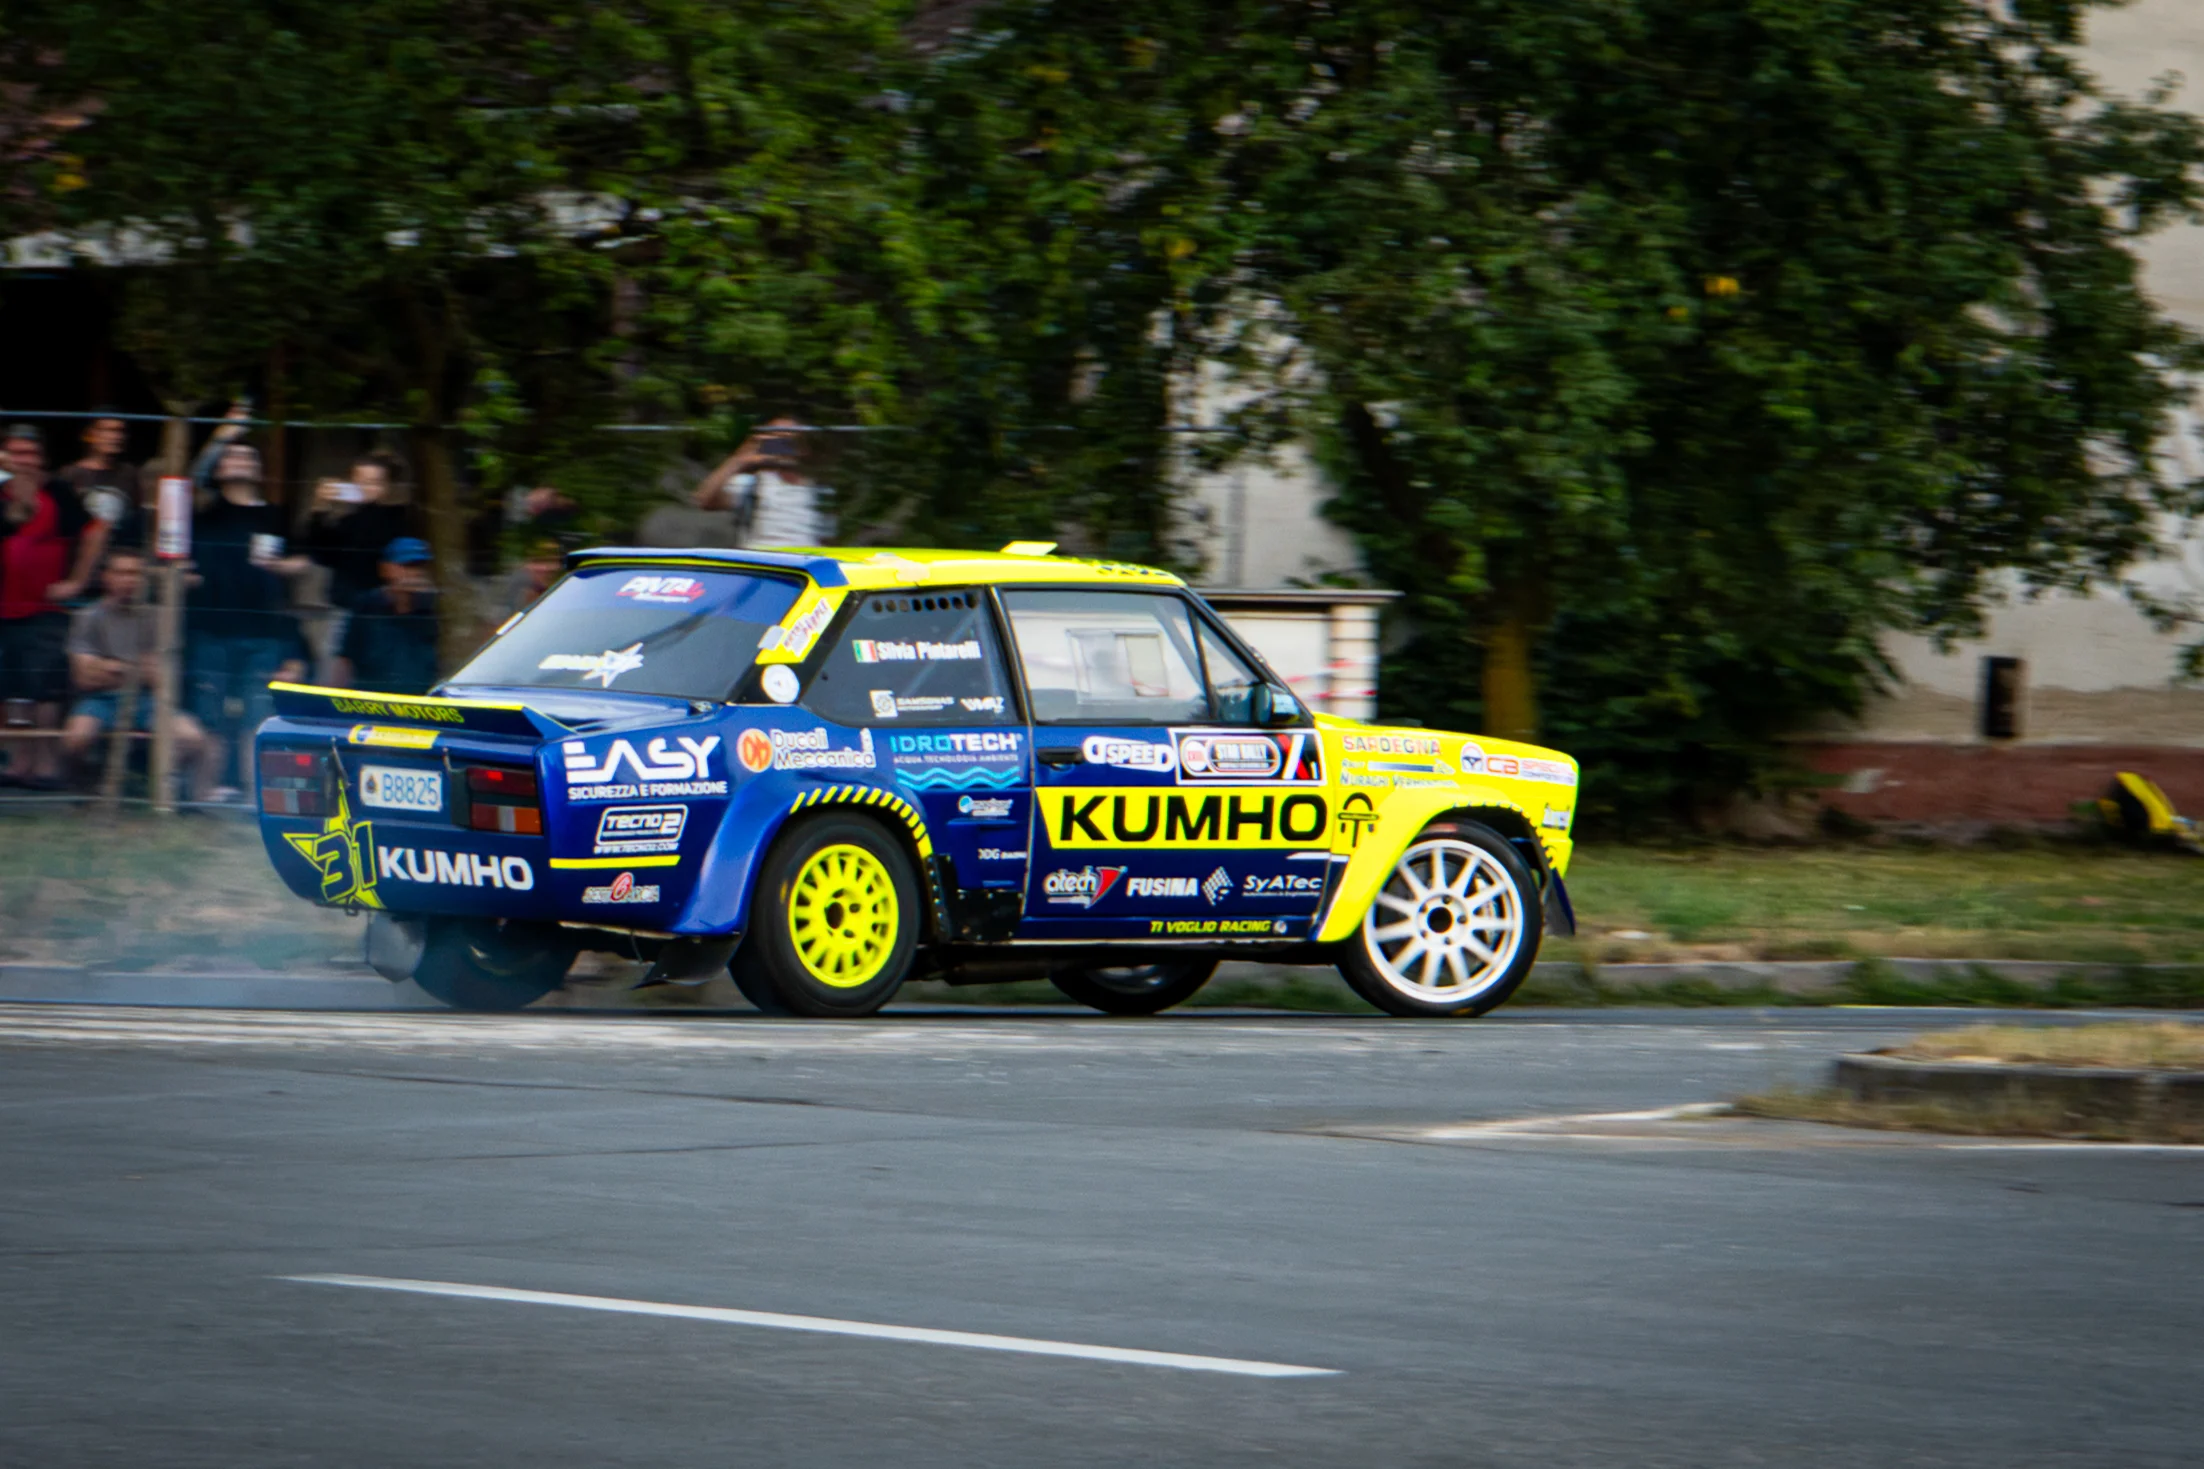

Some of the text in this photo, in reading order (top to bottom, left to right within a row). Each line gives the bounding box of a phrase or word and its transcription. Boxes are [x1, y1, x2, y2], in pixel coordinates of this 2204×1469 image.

[877, 640, 982, 660] Silvia Pintarelli
[389, 703, 464, 723] MOTORS
[772, 728, 828, 749] Ducoli
[890, 733, 1017, 752] IDROTECH
[1343, 736, 1442, 756] SARDEGNA
[563, 735, 721, 784] EASY
[776, 748, 875, 769] Meccanica
[383, 773, 437, 806] B8825
[568, 781, 728, 800] SICUREZZA E FORMAZIONE
[1060, 794, 1327, 842] KUMHO
[313, 821, 377, 901] 31
[378, 846, 535, 891] KUMHO
[1126, 877, 1199, 897] FUSINA
[1243, 874, 1323, 893] SyATec
[1166, 920, 1217, 933] VOGLIO
[1219, 920, 1272, 932] RACING
